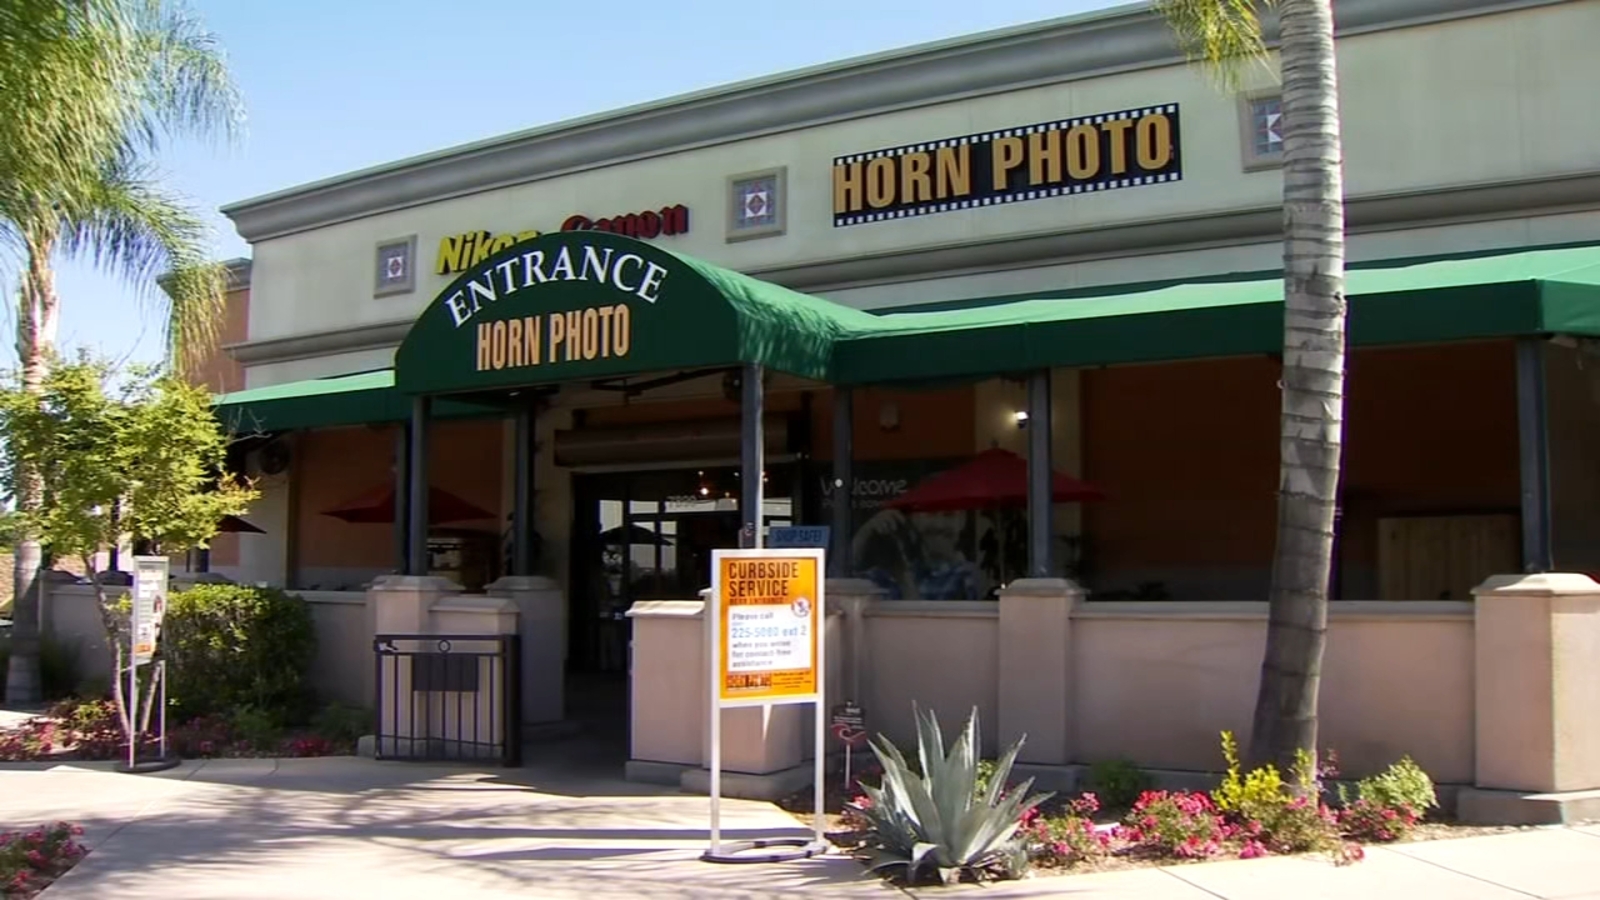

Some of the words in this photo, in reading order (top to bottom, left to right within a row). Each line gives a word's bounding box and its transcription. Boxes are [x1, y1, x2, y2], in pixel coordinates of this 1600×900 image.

[833, 143, 970, 214] HORN
[992, 113, 1171, 191] PHOTO
[445, 245, 668, 328] ENTRANCE
[476, 315, 541, 371] HORN
[549, 304, 630, 363] PHOTO
[729, 562, 799, 579] CURBSIDE
[729, 580, 788, 597] SERVICE
